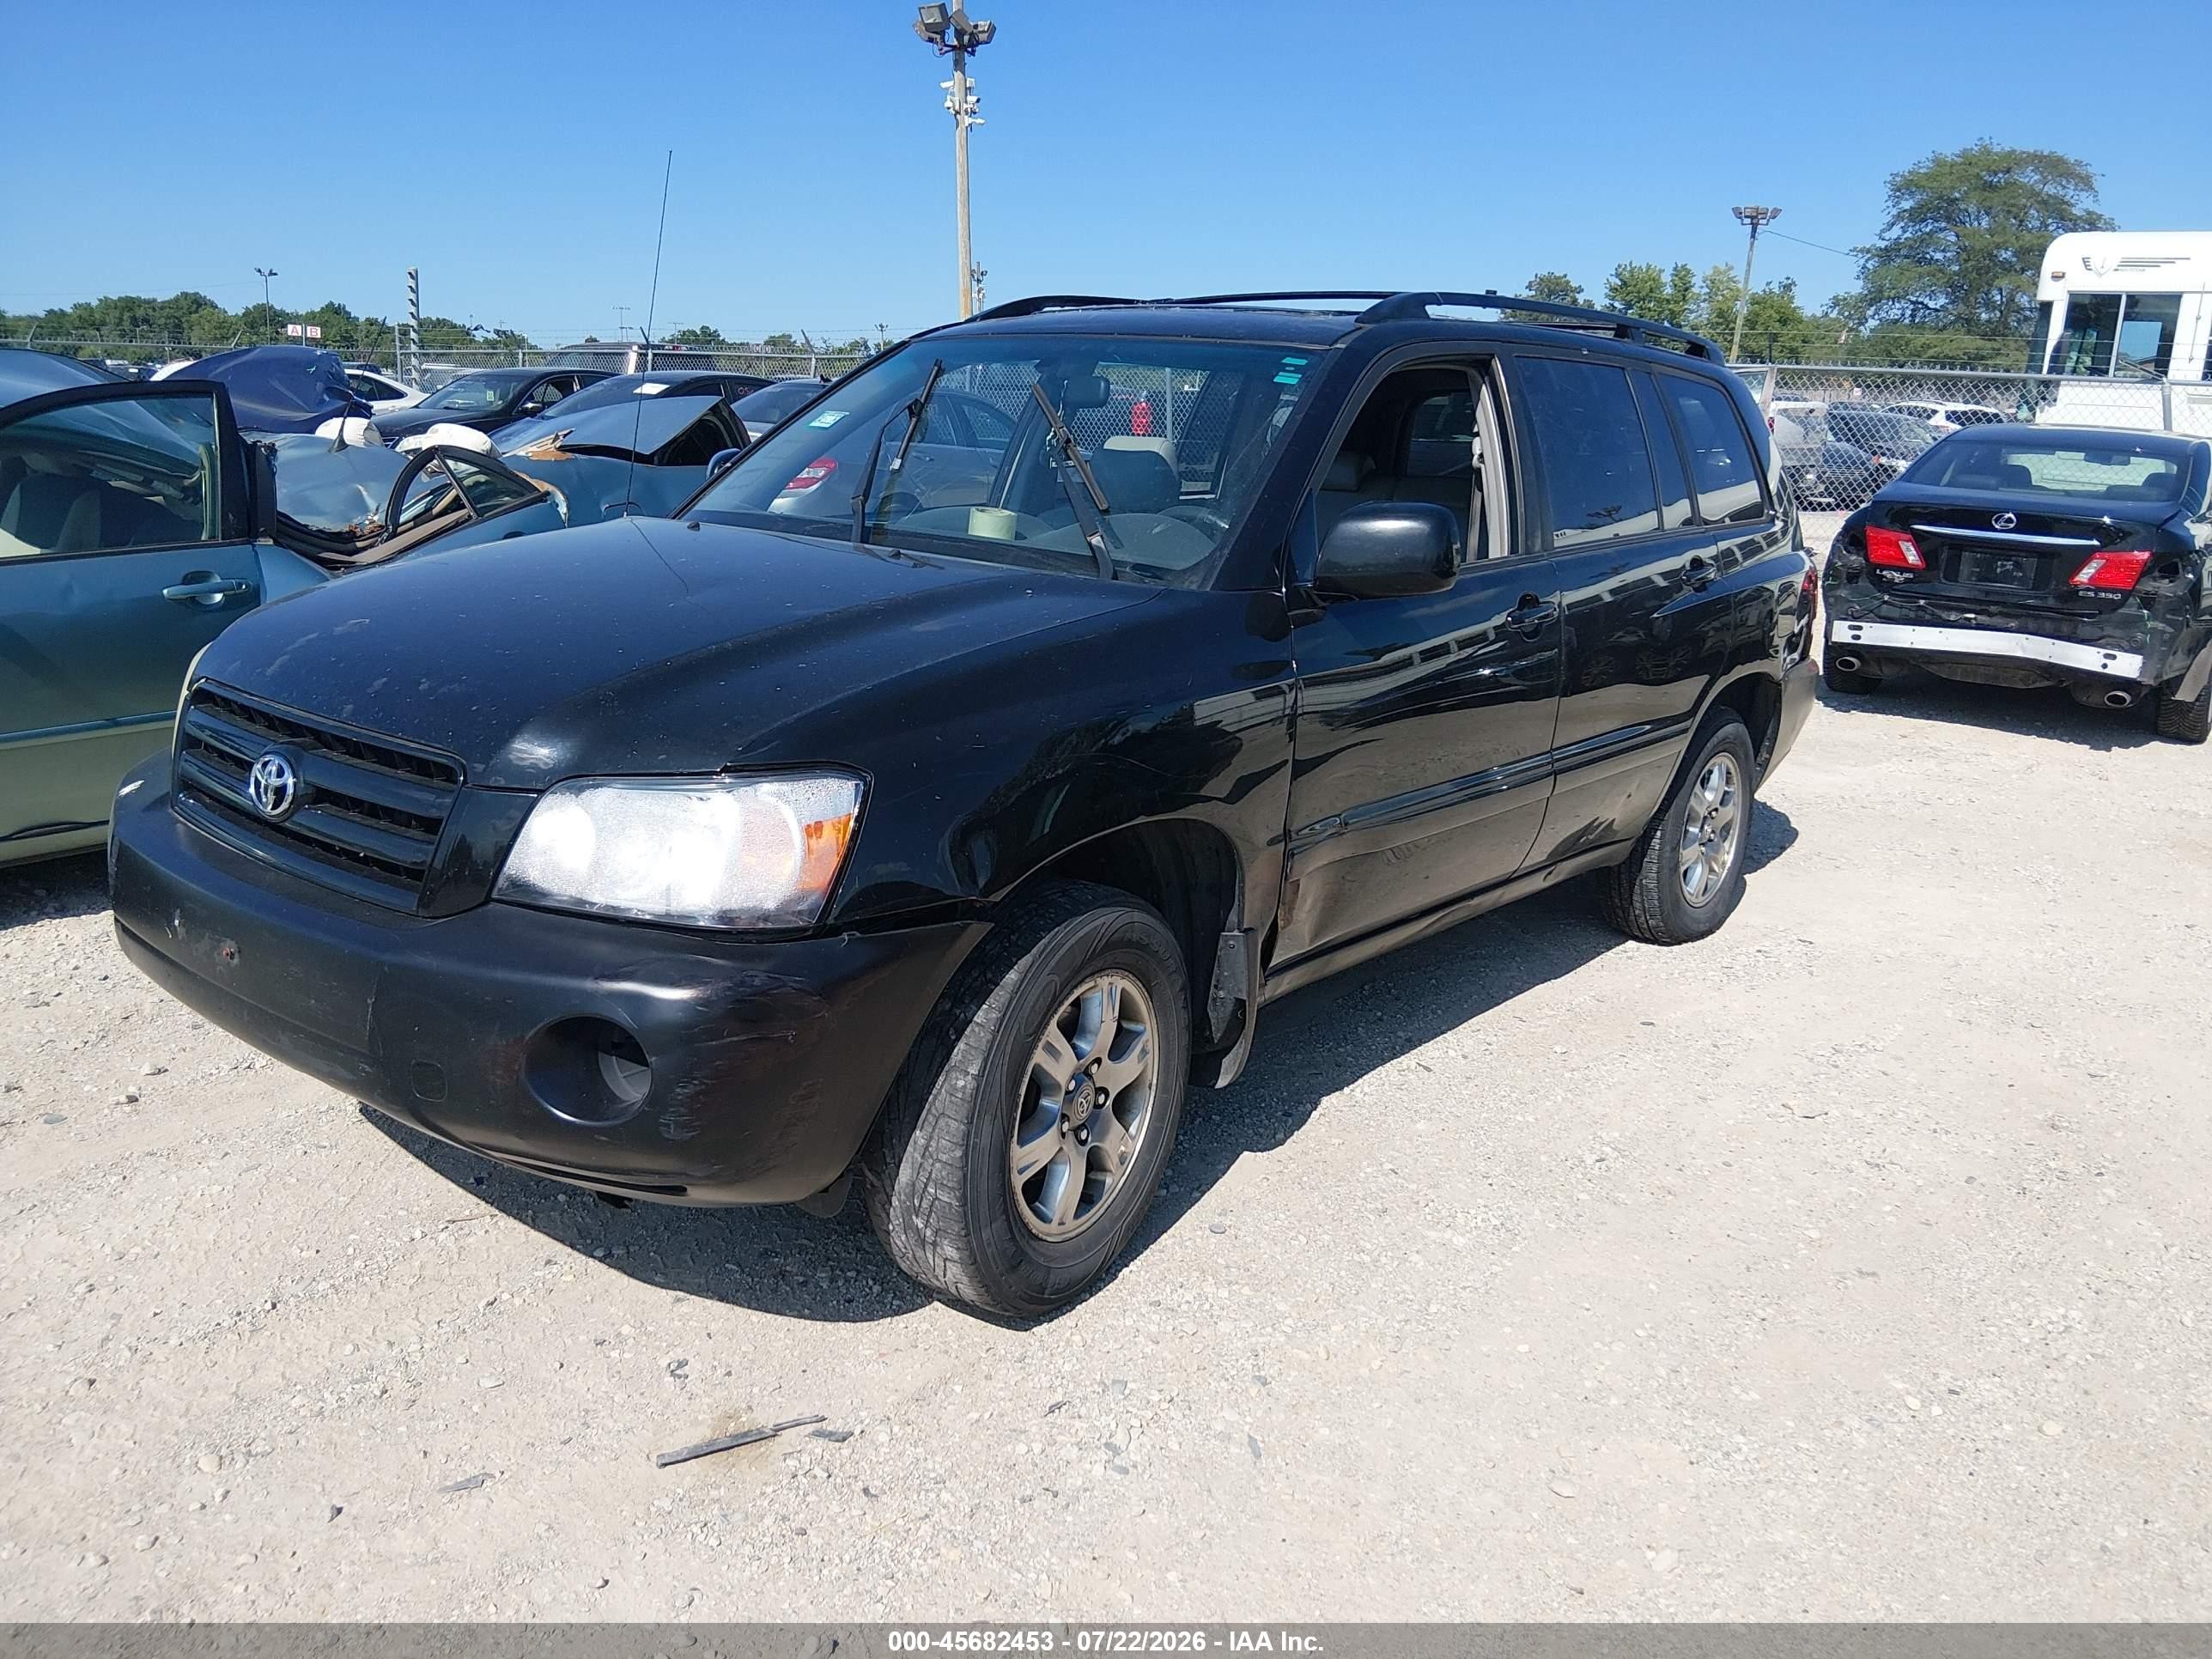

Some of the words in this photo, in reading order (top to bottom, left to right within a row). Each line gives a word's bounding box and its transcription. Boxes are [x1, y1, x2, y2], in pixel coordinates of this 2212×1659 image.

[291, 326, 300, 336] A
[310, 327, 319, 337] B
[1875, 568, 1915, 579] LEXUS
